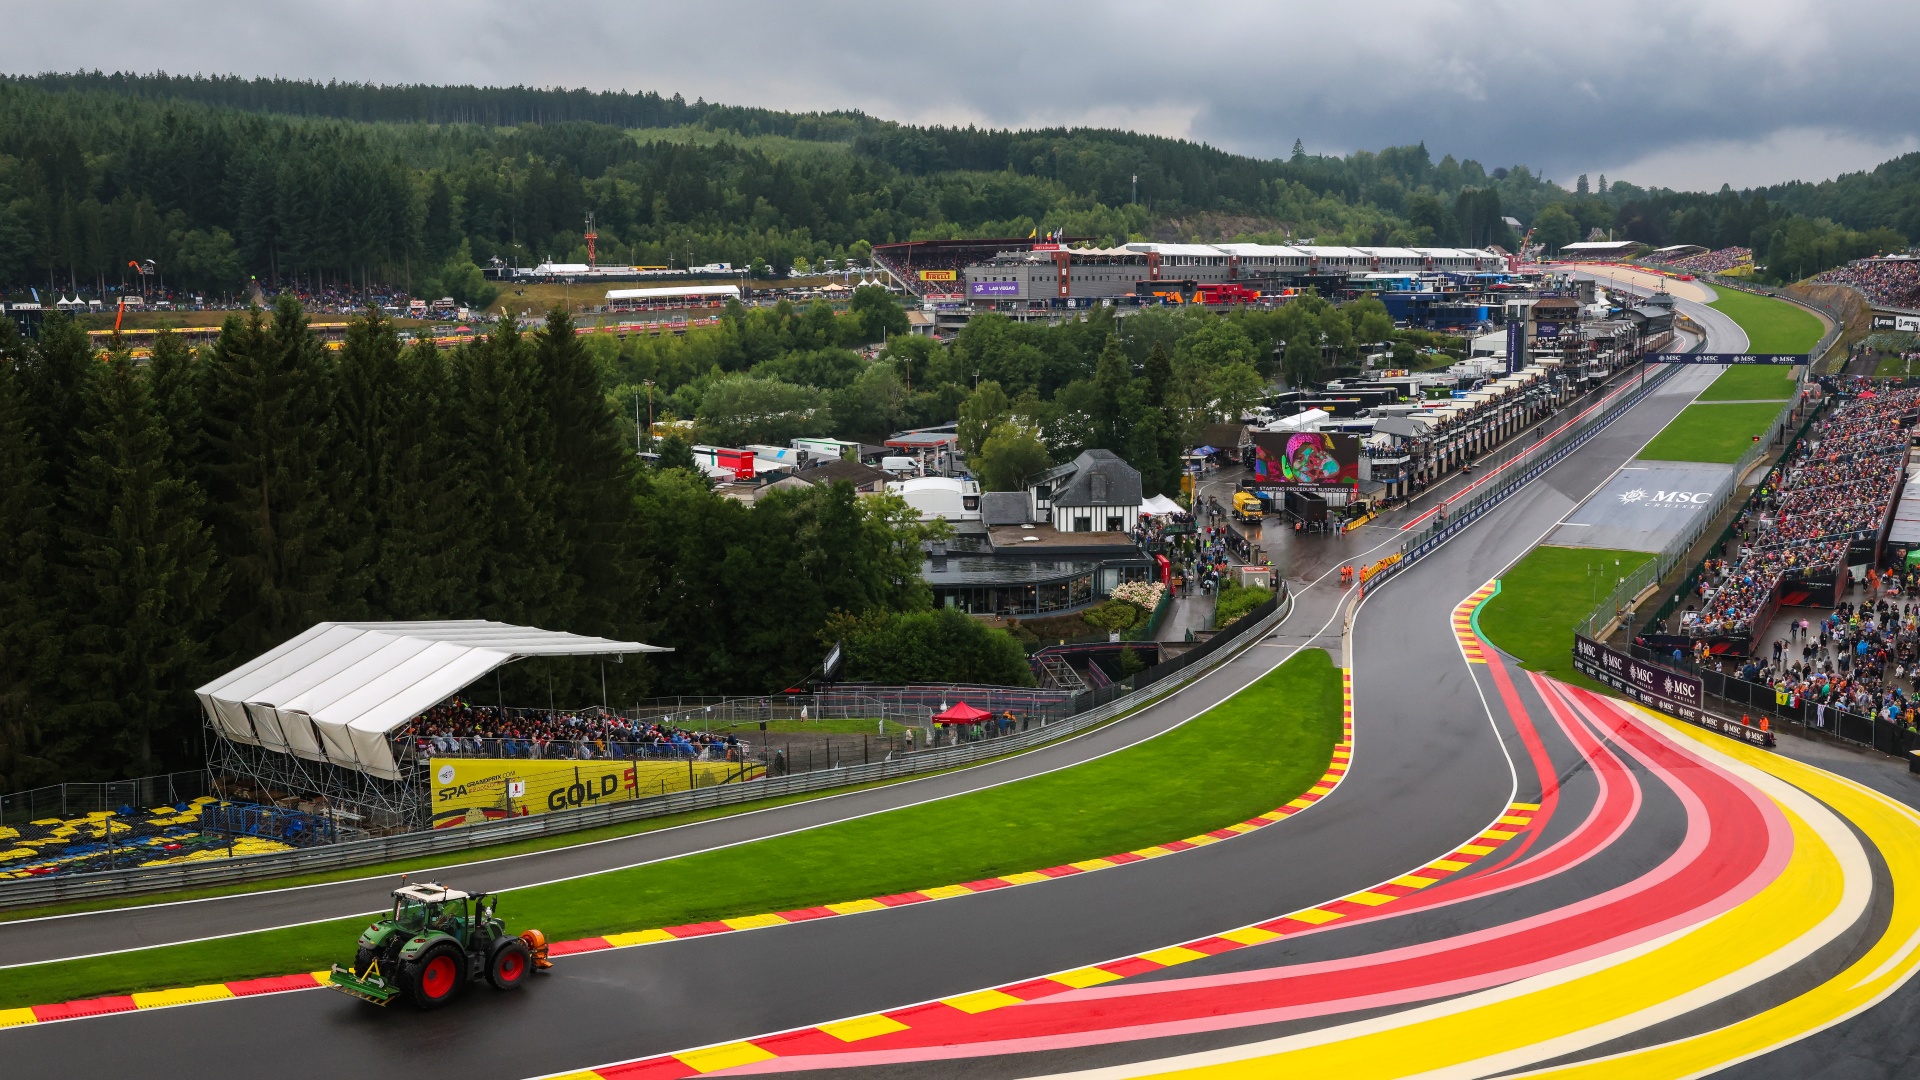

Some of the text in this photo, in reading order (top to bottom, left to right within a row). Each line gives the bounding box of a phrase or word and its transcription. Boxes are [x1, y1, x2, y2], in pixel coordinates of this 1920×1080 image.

[1649, 491, 1712, 503] MSC
[1583, 642, 1595, 658] MSC
[1609, 654, 1622, 670] MSC
[1637, 667, 1653, 683] MSC
[1674, 680, 1695, 697] MSC
[1664, 702, 1673, 710] MSC
[1684, 709, 1694, 718] MSC
[1706, 717, 1717, 726] MSC
[1729, 725, 1740, 734] MSC
[1751, 732, 1764, 741] MSC
[439, 785, 467, 802] SPA
[548, 774, 617, 811] GOLD
